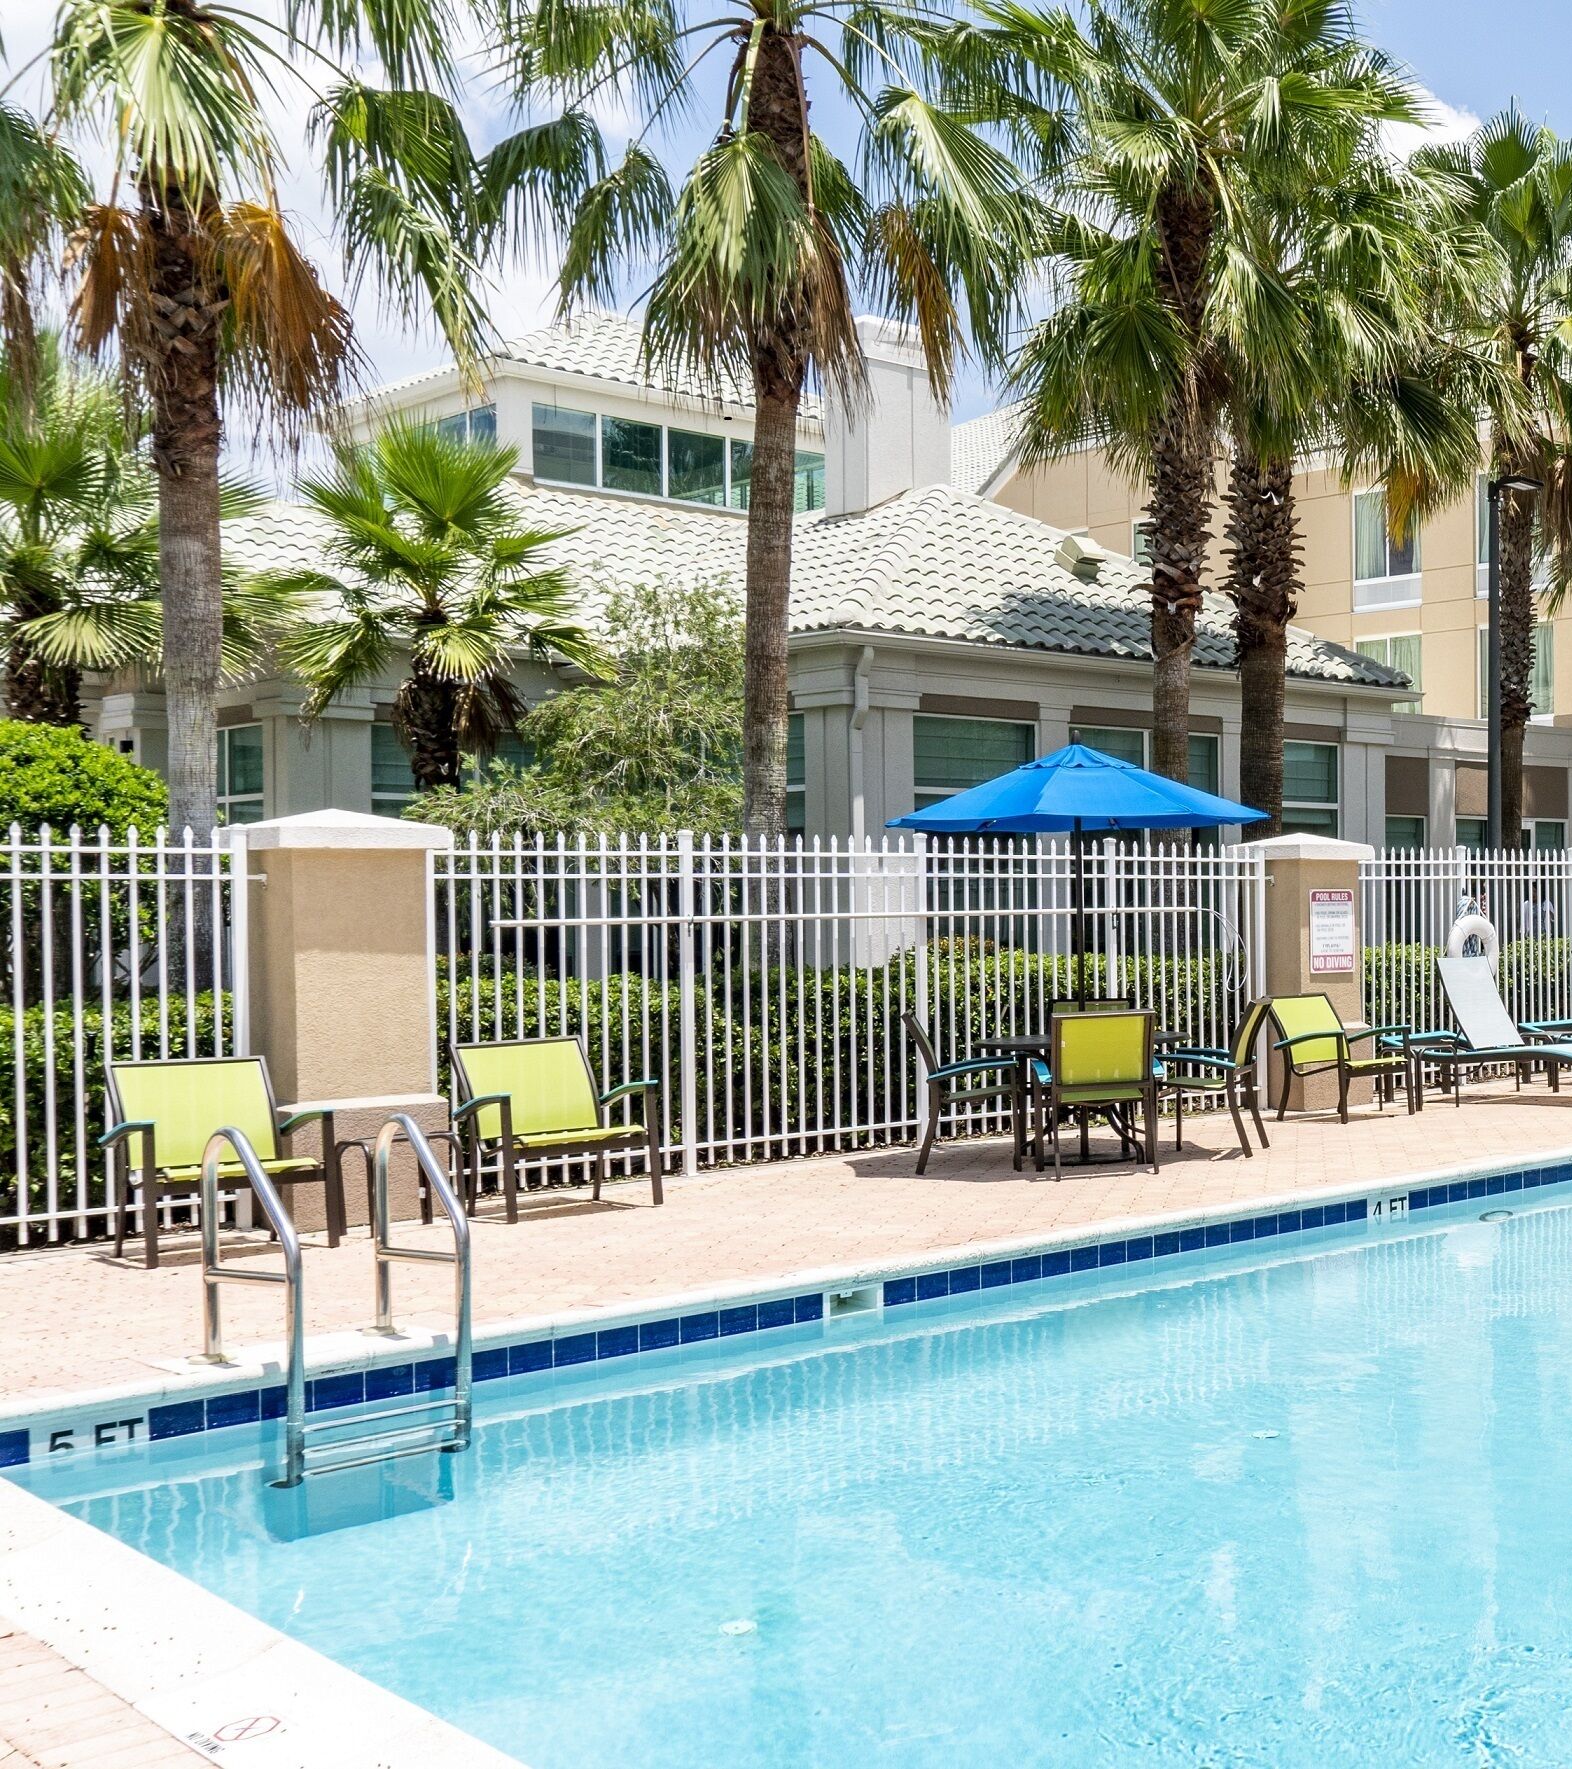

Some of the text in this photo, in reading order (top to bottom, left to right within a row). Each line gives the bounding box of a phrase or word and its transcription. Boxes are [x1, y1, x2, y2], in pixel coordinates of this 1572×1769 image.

[1314, 956, 1352, 969] NO DIVING
[1390, 1196, 1407, 1212] FT
[49, 1417, 144, 1452] 5 FT
